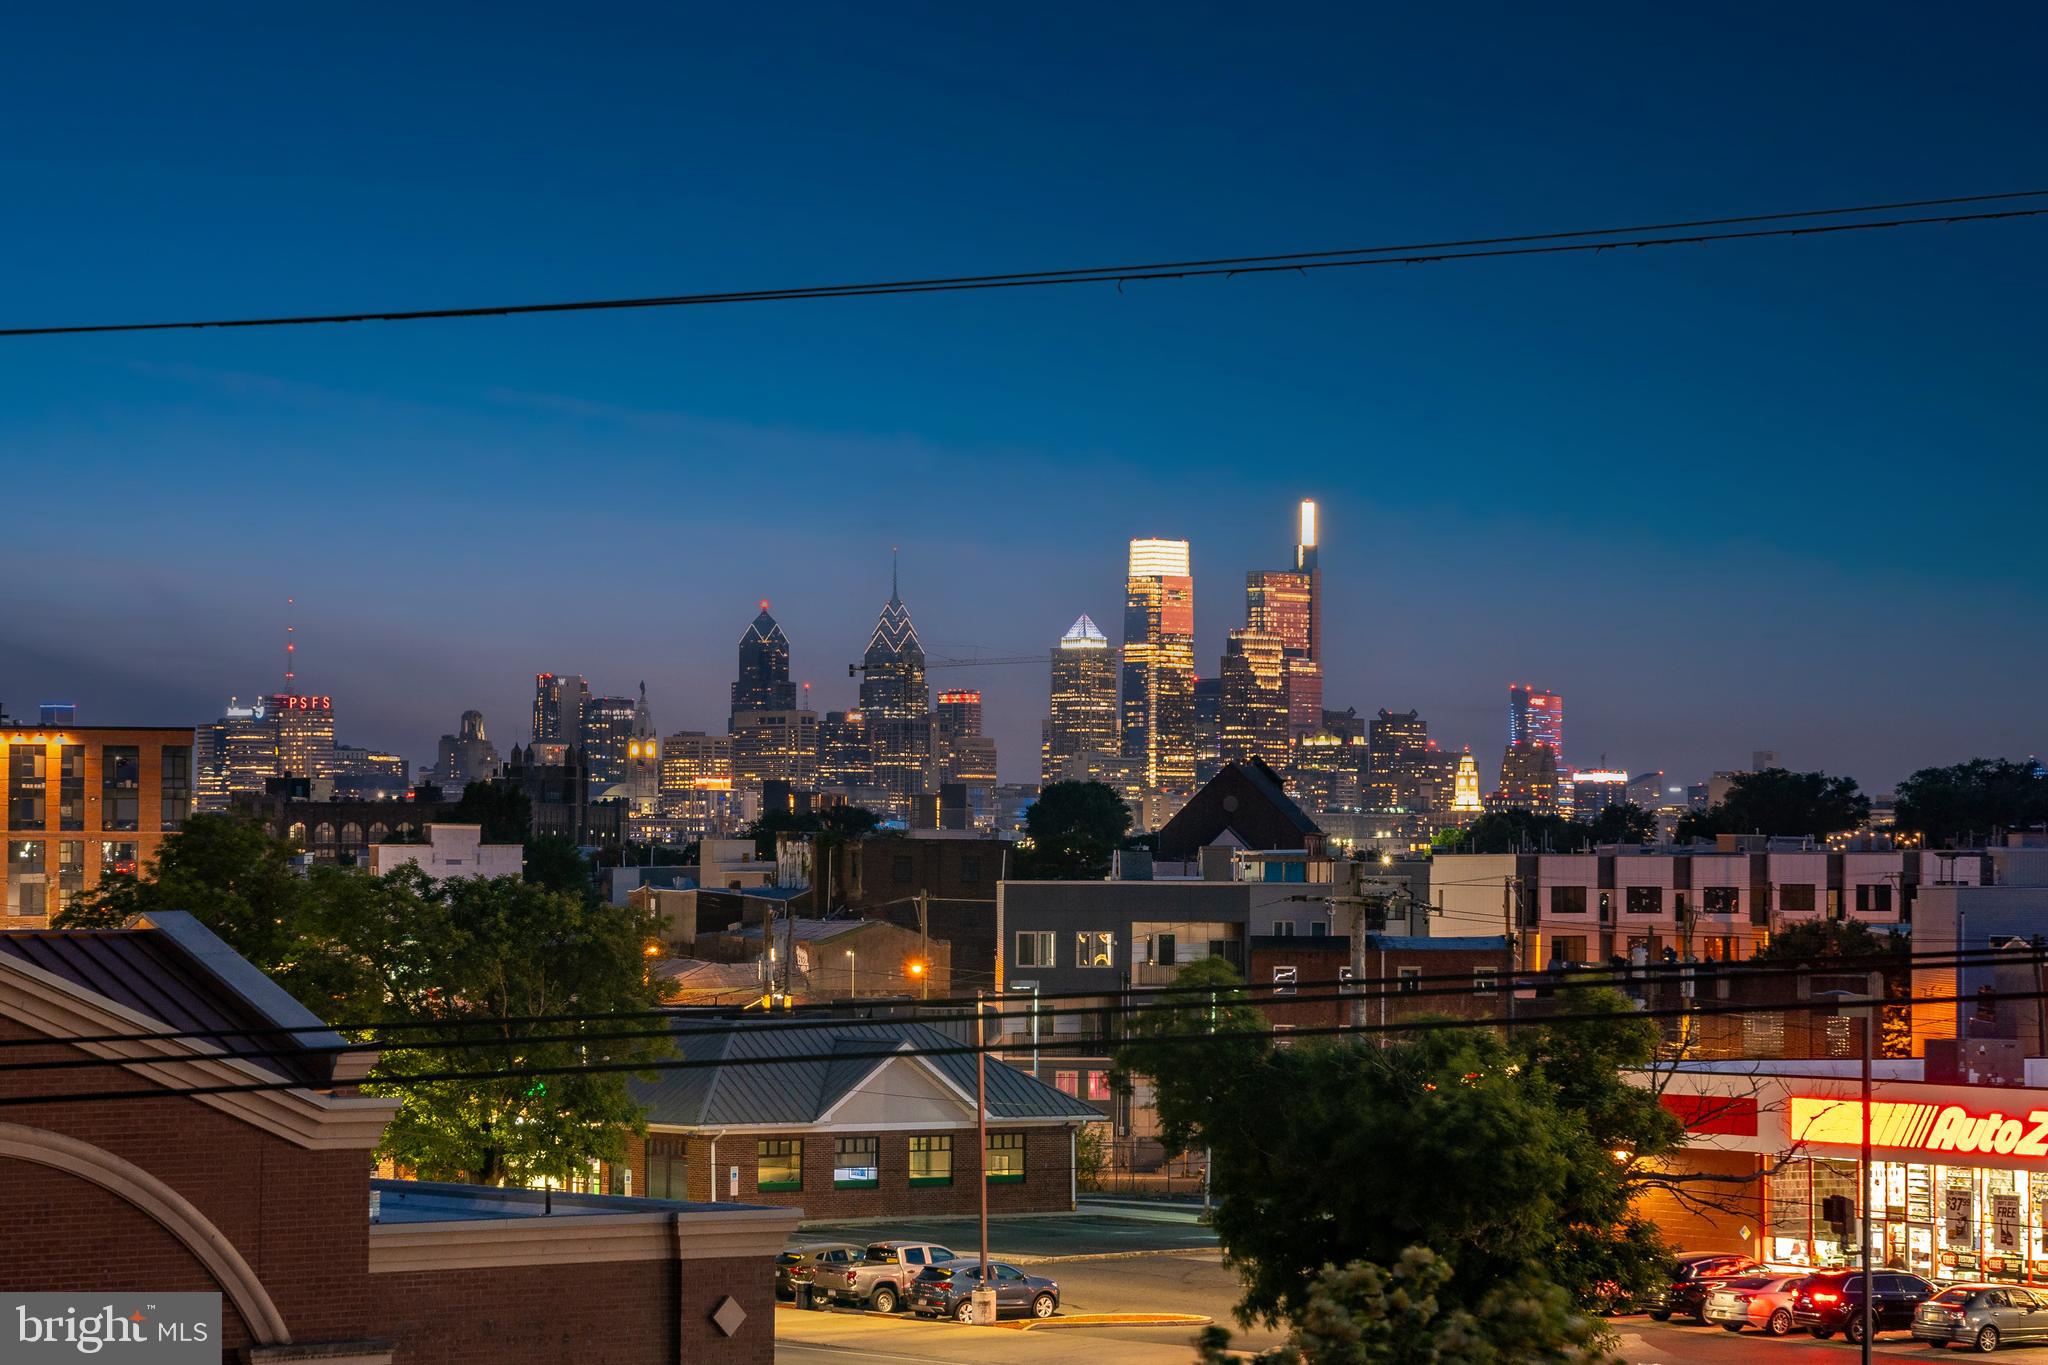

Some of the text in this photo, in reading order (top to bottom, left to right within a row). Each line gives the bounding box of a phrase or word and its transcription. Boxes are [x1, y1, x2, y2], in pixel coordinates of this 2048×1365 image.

[289, 696, 330, 709] PSFS
[1997, 1206, 2017, 1218] FREE
[1942, 1254, 1956, 1265] FREE
[1989, 1259, 2002, 1269] FREE
